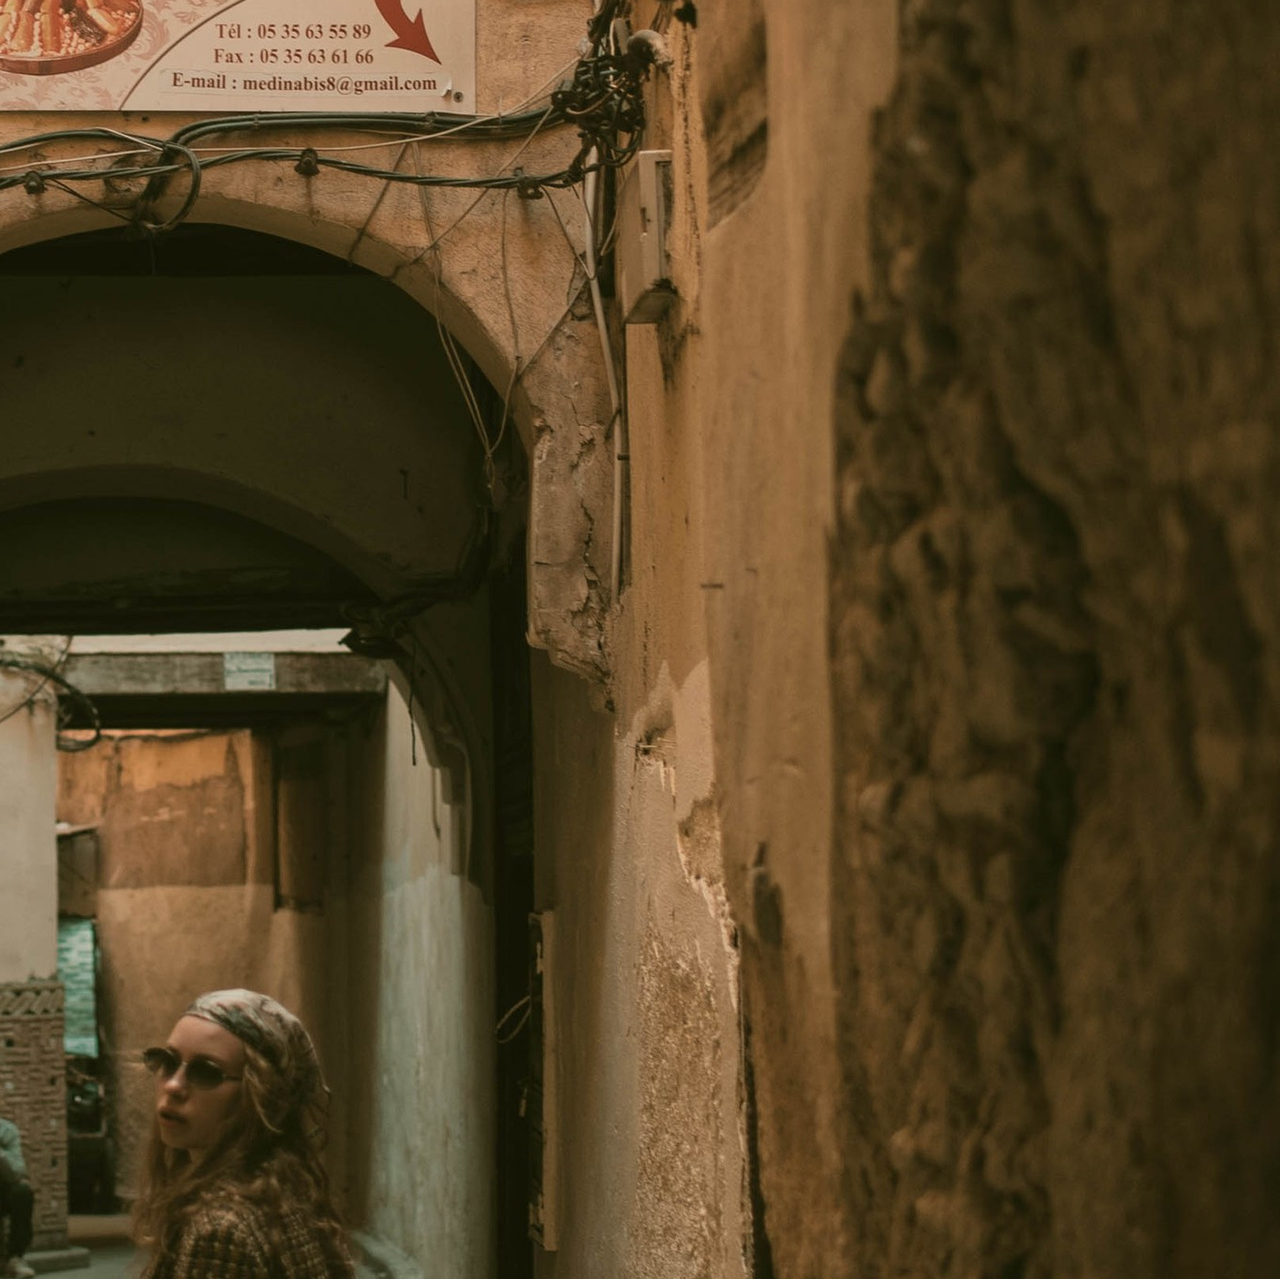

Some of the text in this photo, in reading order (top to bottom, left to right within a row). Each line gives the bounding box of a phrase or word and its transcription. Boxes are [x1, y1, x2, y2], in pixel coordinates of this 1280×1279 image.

[216, 23, 242, 40] Tél
[257, 23, 277, 40] 05
[280, 23, 301, 40] 35
[304, 23, 325, 40] 63
[328, 23, 349, 40] 55
[352, 23, 372, 40] 89
[213, 48, 244, 64] Fax
[259, 48, 279, 64] 05
[282, 48, 303, 64] 35
[306, 48, 327, 64] 63
[331, 48, 349, 64] 61
[354, 48, 374, 64] 66
[172, 72, 227, 90] E-mail
[242, 75, 438, 96] medinabis8@gmail.com
